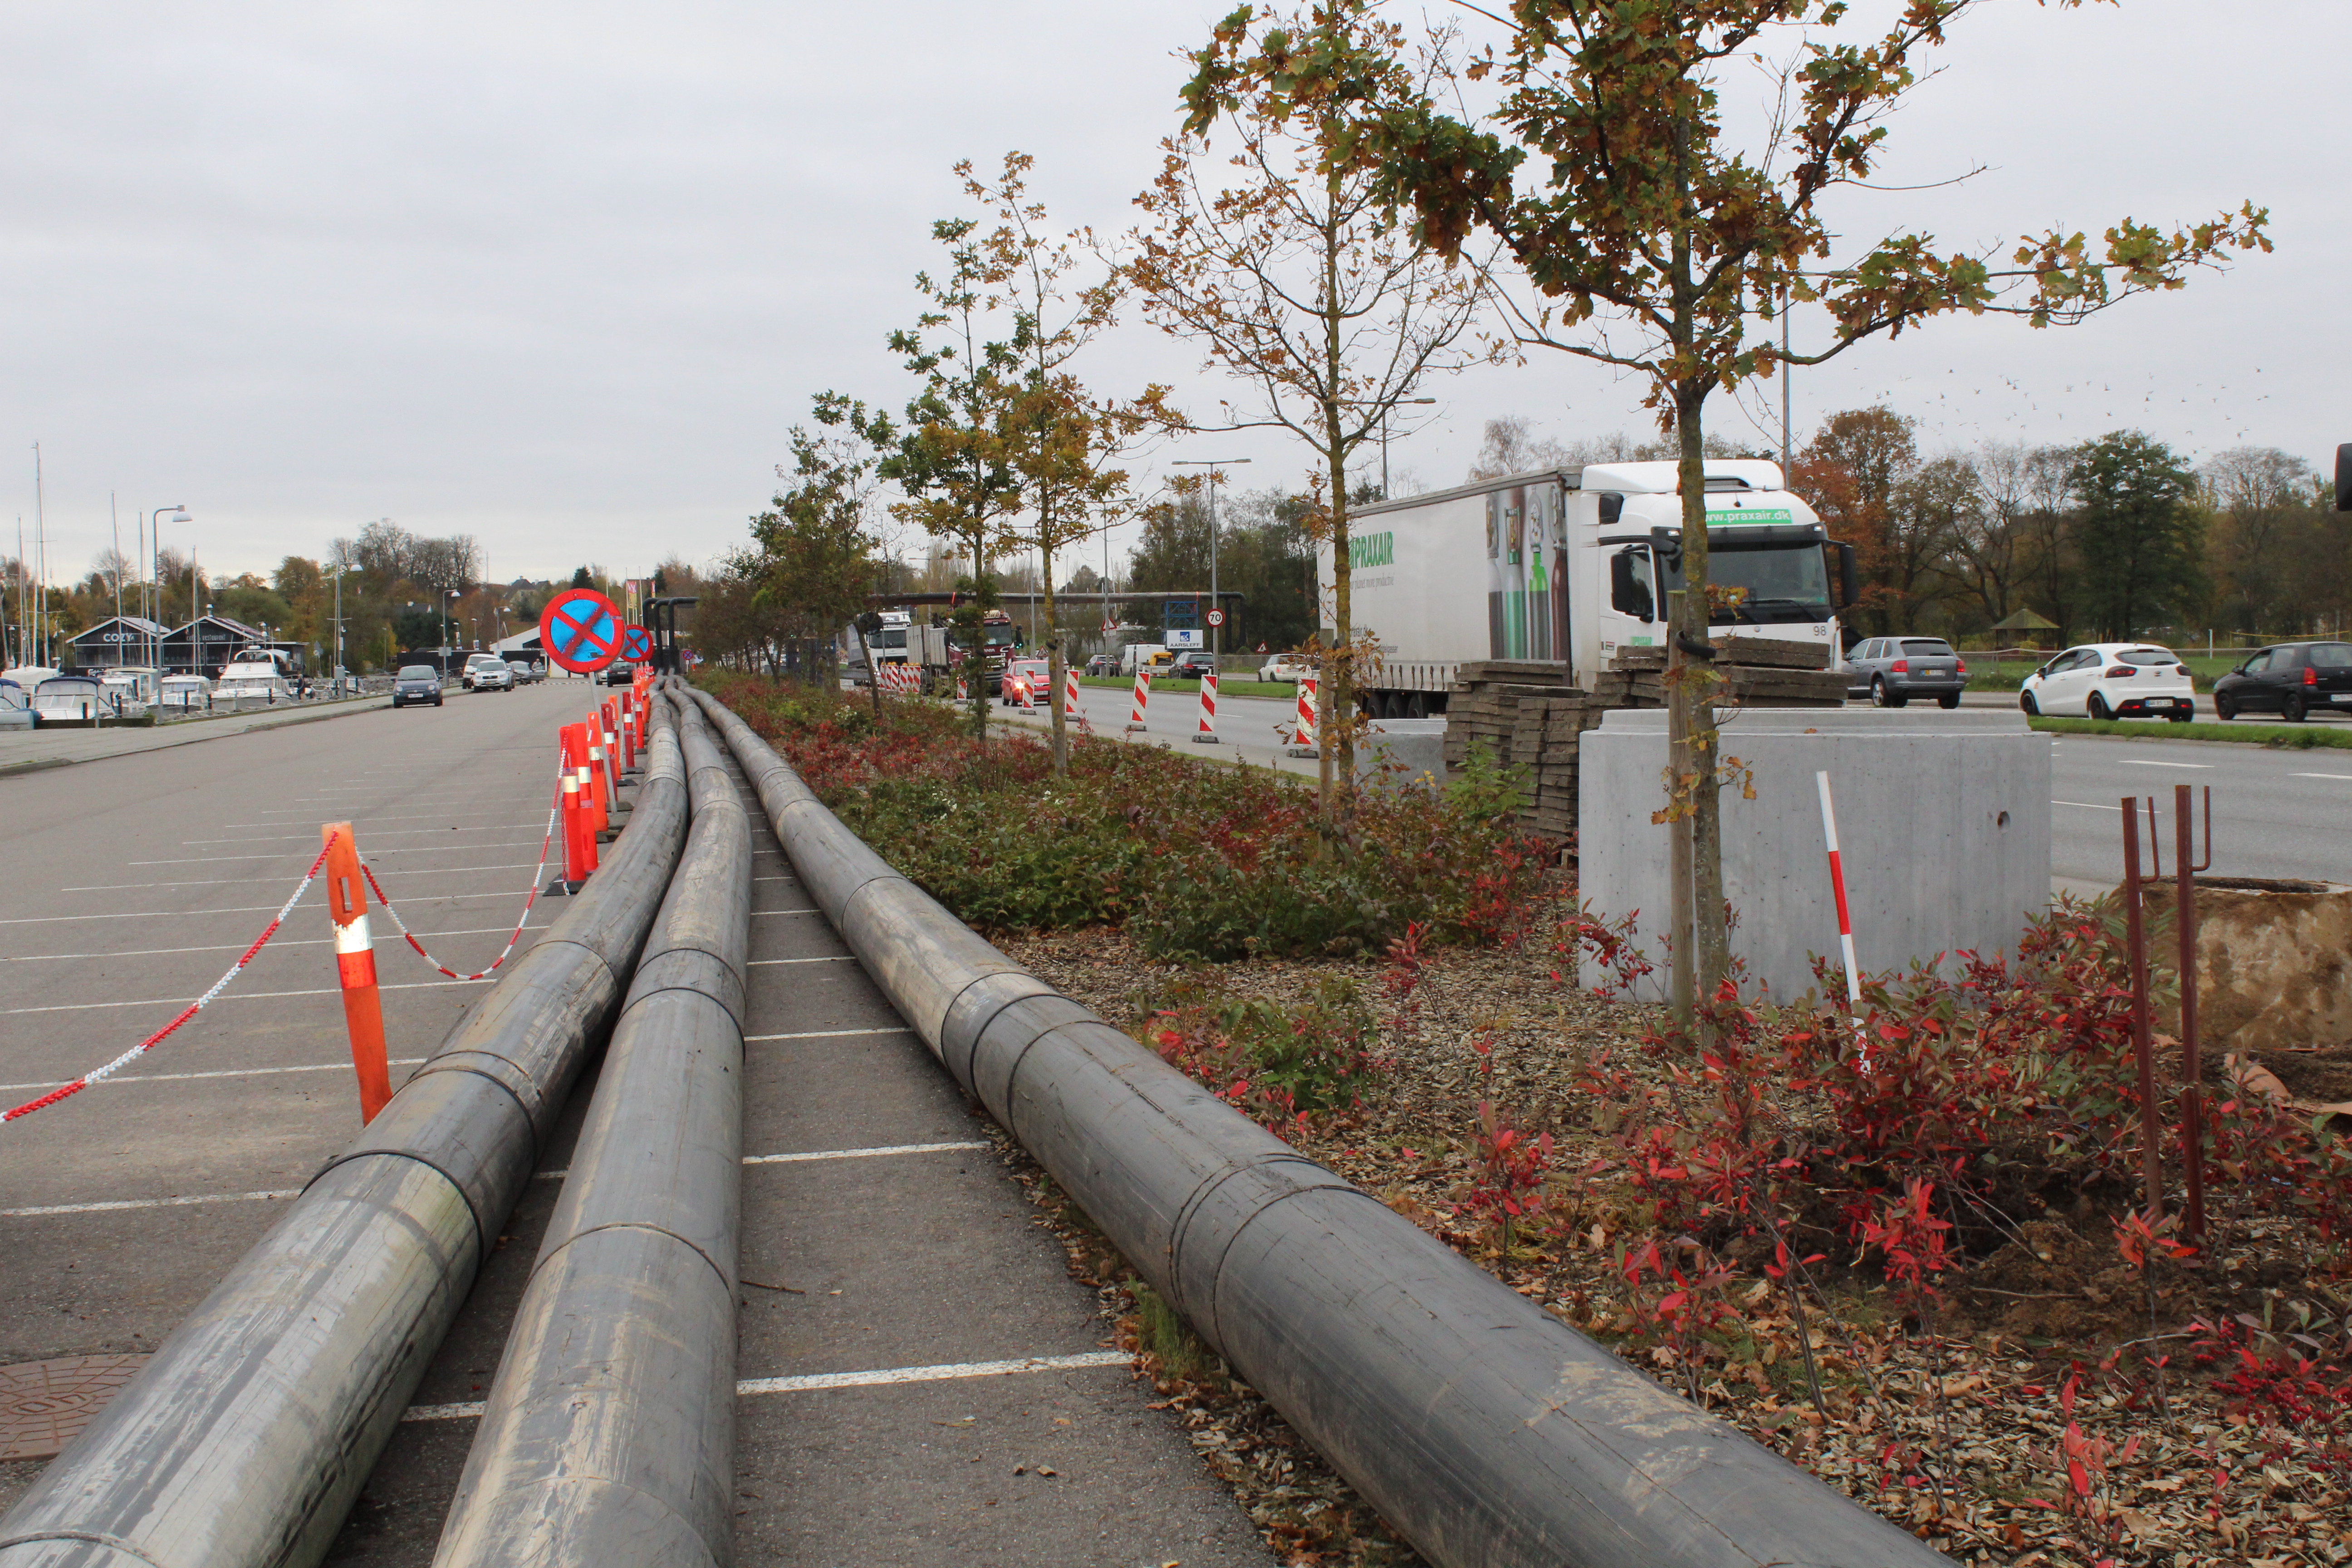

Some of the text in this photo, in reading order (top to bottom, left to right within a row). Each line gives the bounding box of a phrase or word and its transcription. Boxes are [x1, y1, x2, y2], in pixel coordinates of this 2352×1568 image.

[1706, 511, 1790, 523] ww.praxair.dk
[1355, 532, 1393, 569] PRAXAIR
[1814, 626, 1826, 636] 98
[103, 633, 133, 642] COZY
